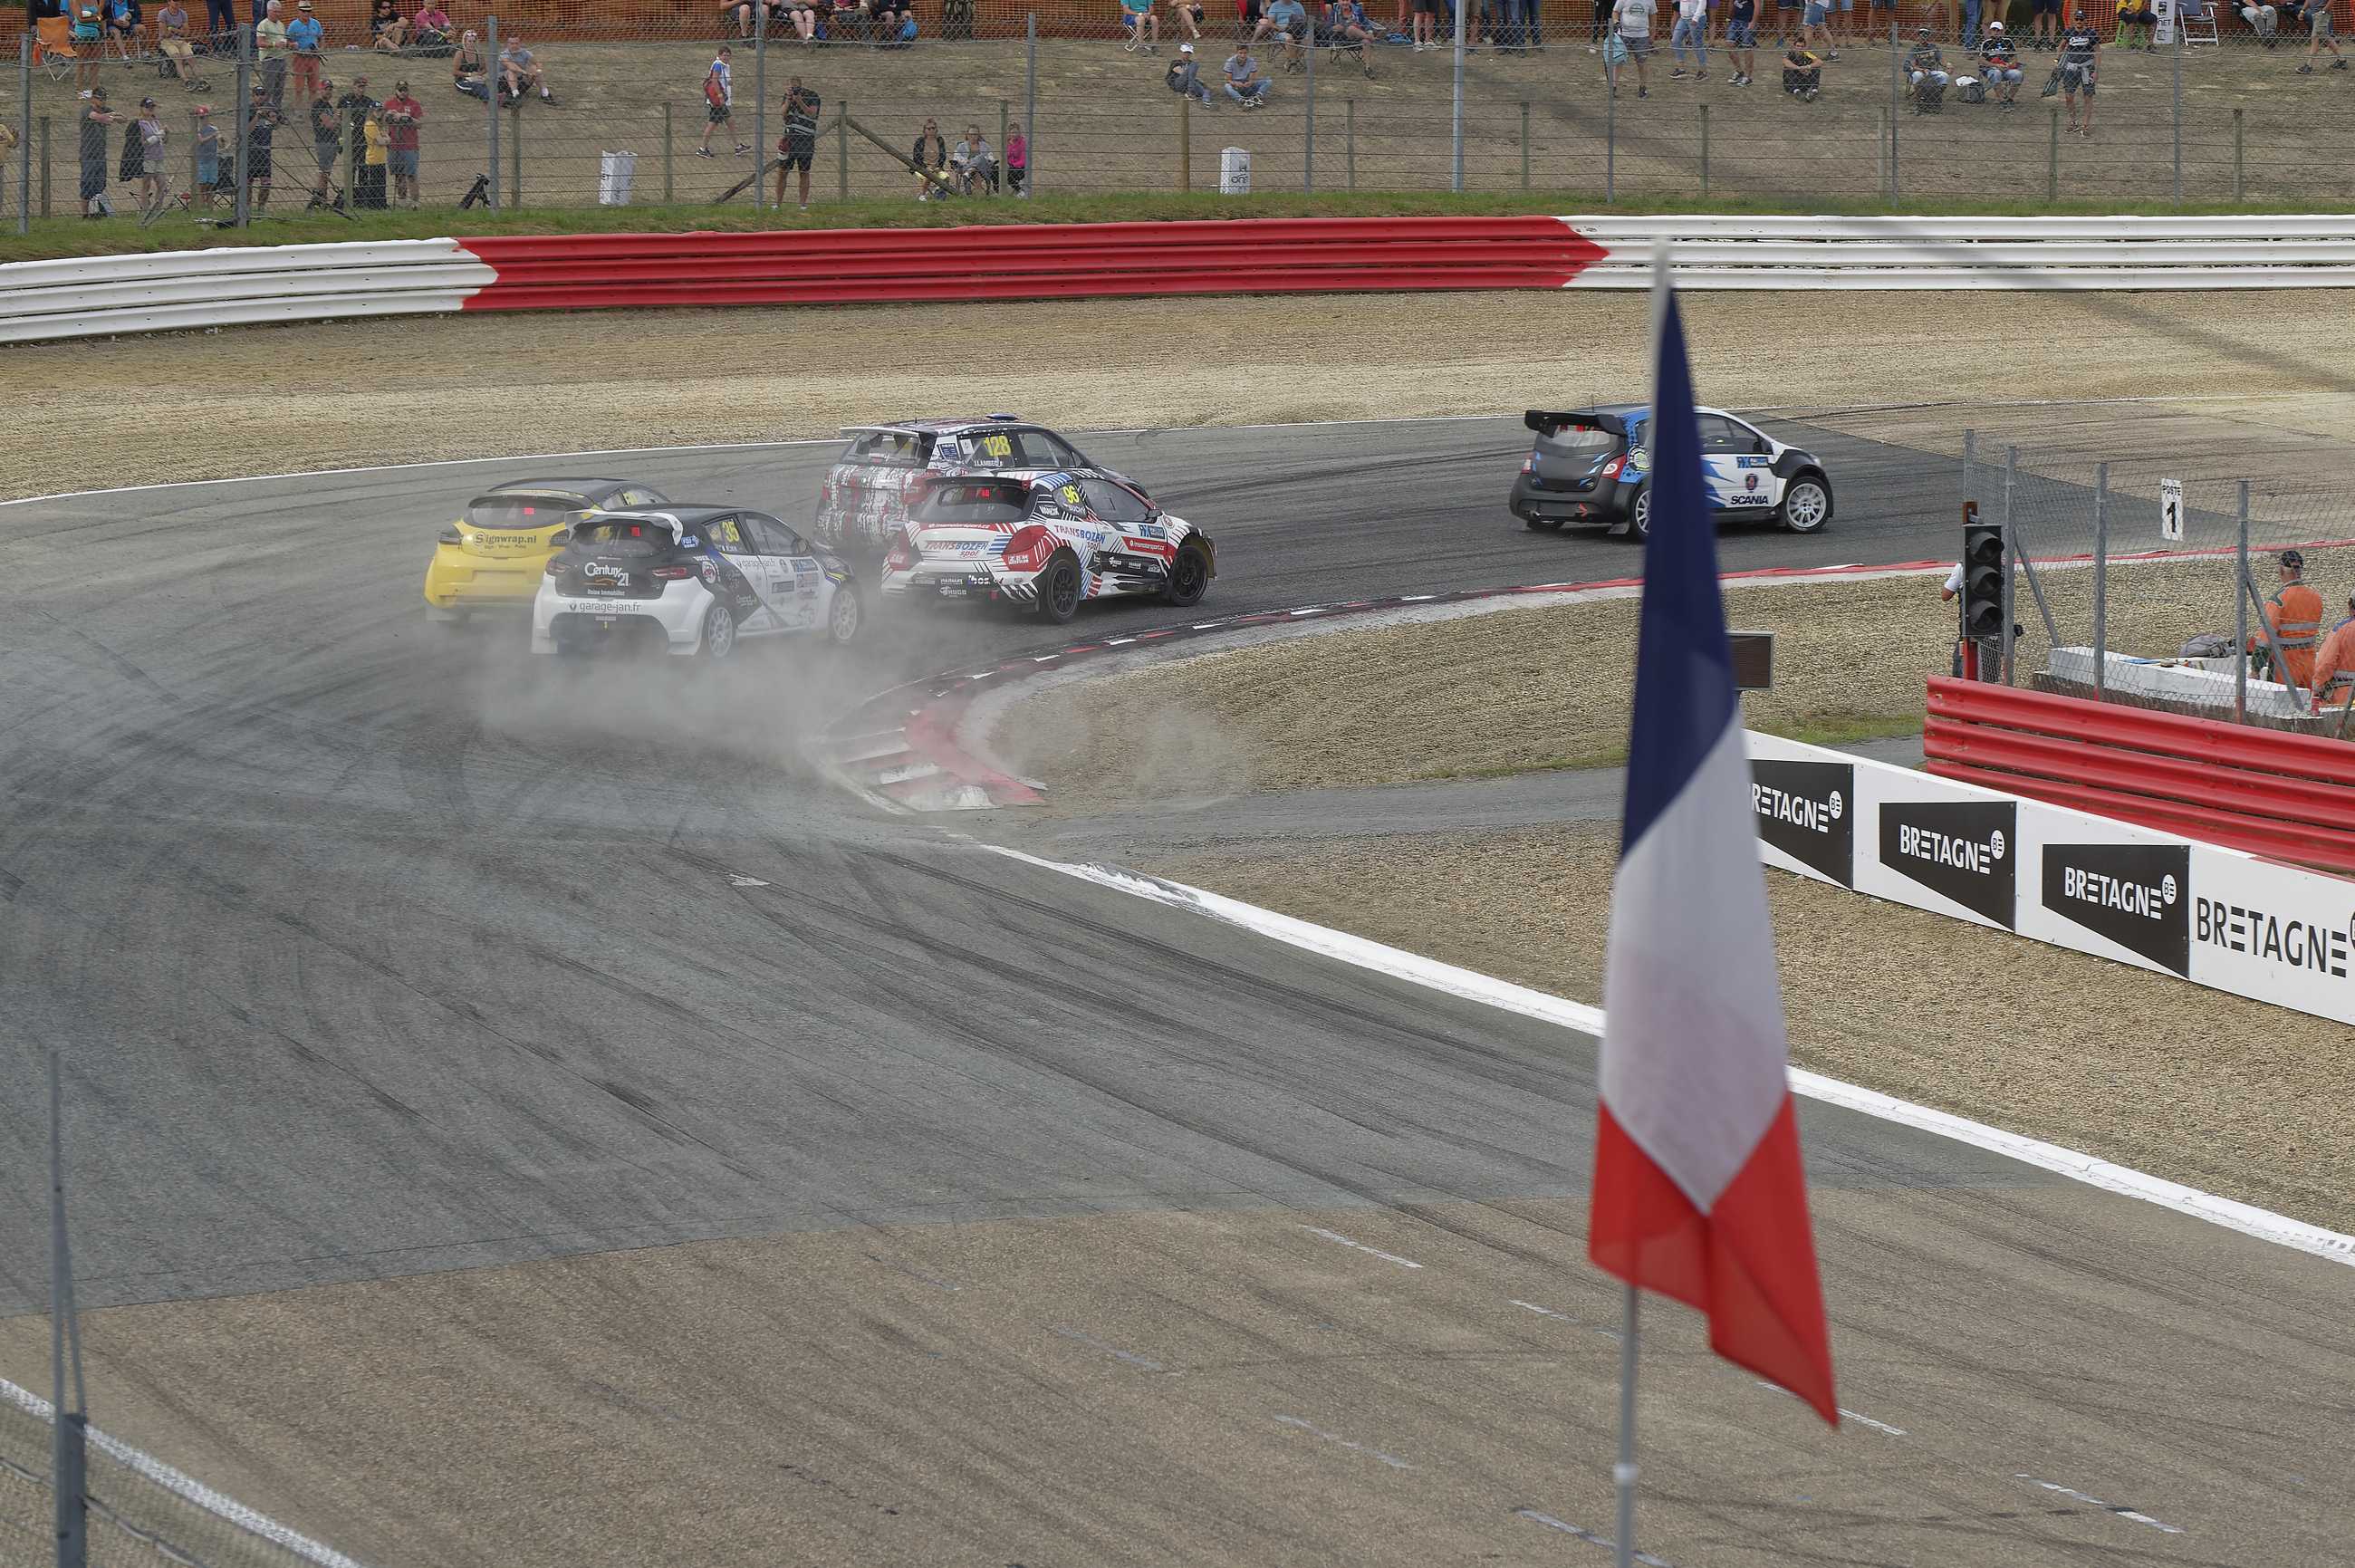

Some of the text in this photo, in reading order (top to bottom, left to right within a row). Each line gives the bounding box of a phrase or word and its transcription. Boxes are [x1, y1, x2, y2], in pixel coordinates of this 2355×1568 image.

[985, 436, 1012, 457] 128
[1062, 485, 1080, 504] 96
[2162, 485, 2181, 495] POSTE
[1731, 495, 1769, 505] SCANIA
[2167, 502, 2177, 533] 1
[474, 532, 537, 545] Signwrap.nl
[720, 521, 740, 543] 35
[1054, 524, 1106, 544] TRANSBOZEN
[926, 541, 989, 550] TRANSBOZEN
[584, 562, 622, 578] Century
[617, 573, 630, 587] 21
[580, 601, 641, 612] garage-jan.fr
[1750, 782, 1829, 833] RETAGNE
[1899, 823, 1991, 875] BRETAGNE
[2064, 866, 2162, 920] BRETAGNE
[2196, 897, 2347, 978] BRETAGNE
